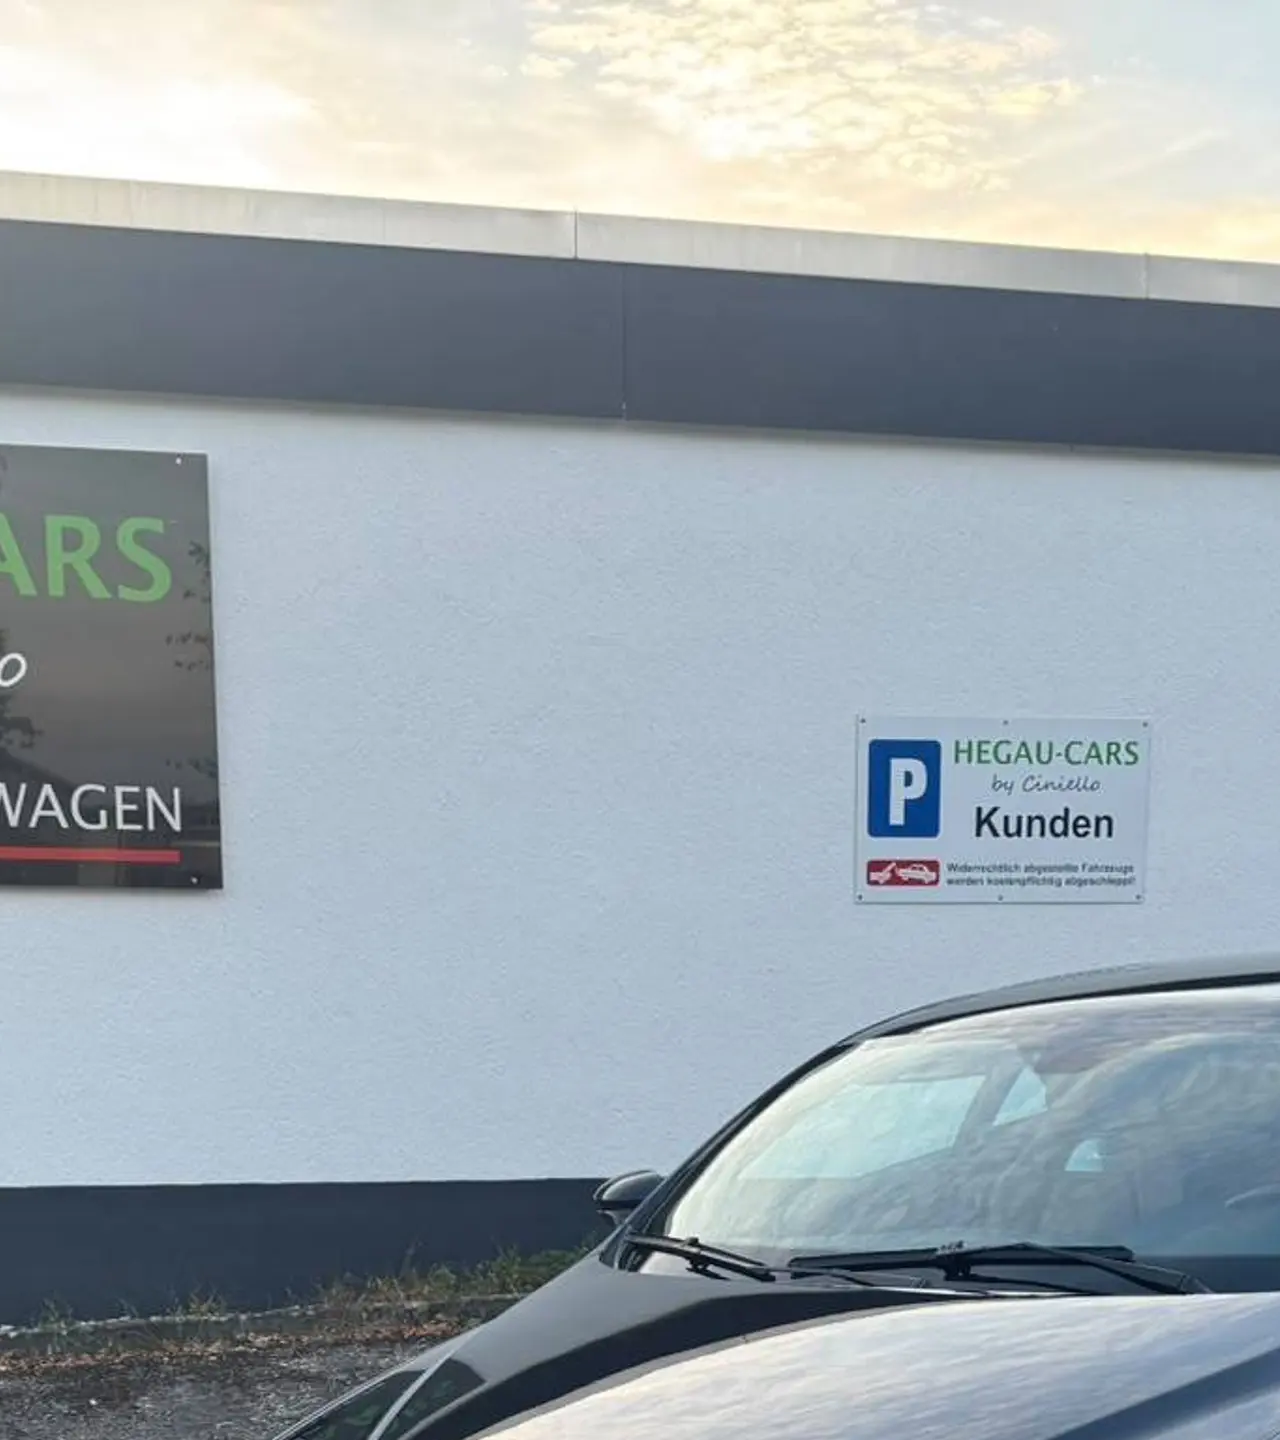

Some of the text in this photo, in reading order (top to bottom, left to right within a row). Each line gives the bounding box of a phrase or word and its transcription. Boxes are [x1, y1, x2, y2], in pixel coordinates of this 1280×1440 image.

[954, 740, 1139, 766] HEGAU-CARS
[889, 757, 928, 826] P
[992, 774, 1102, 796] by Ciniello
[975, 806, 1114, 838] Kunden
